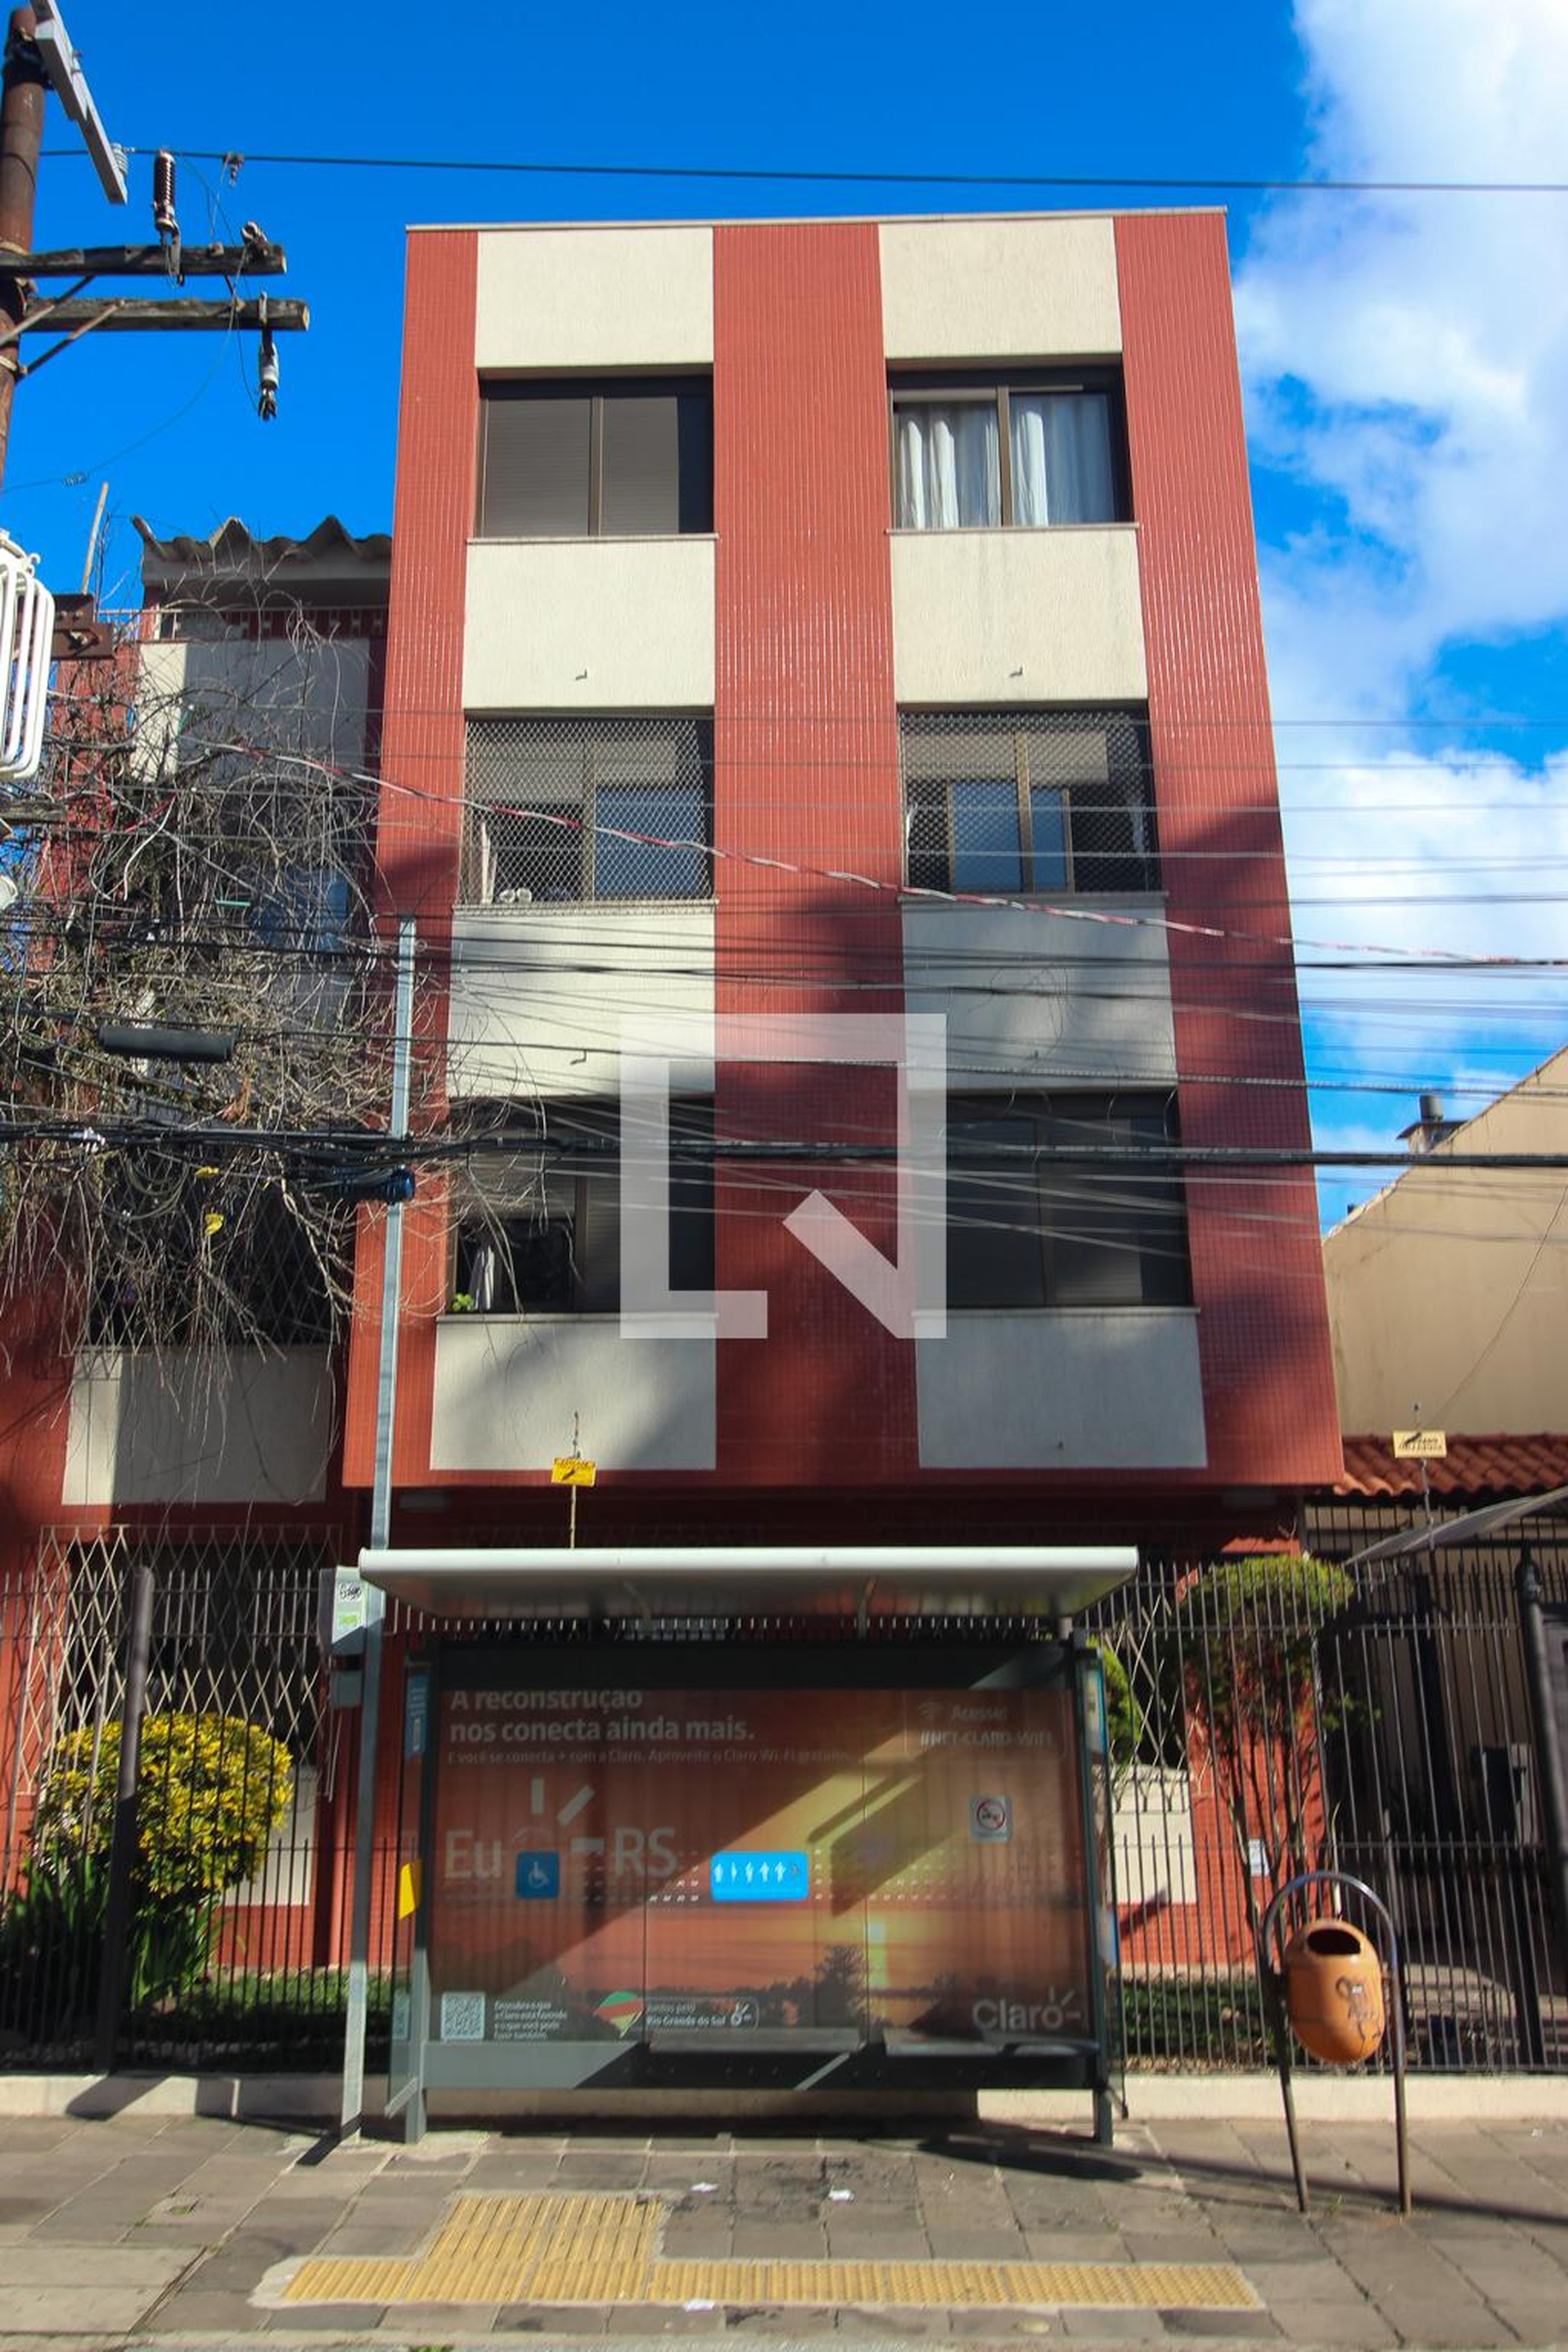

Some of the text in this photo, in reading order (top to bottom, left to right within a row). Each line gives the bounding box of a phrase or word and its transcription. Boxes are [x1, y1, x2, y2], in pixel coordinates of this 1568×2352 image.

[451, 1690, 468, 1710] A
[450, 1715, 755, 1742] nos conecta ainda mais.
[445, 1827, 678, 1879] Eu RS
[973, 1993, 1072, 2032] Claro
